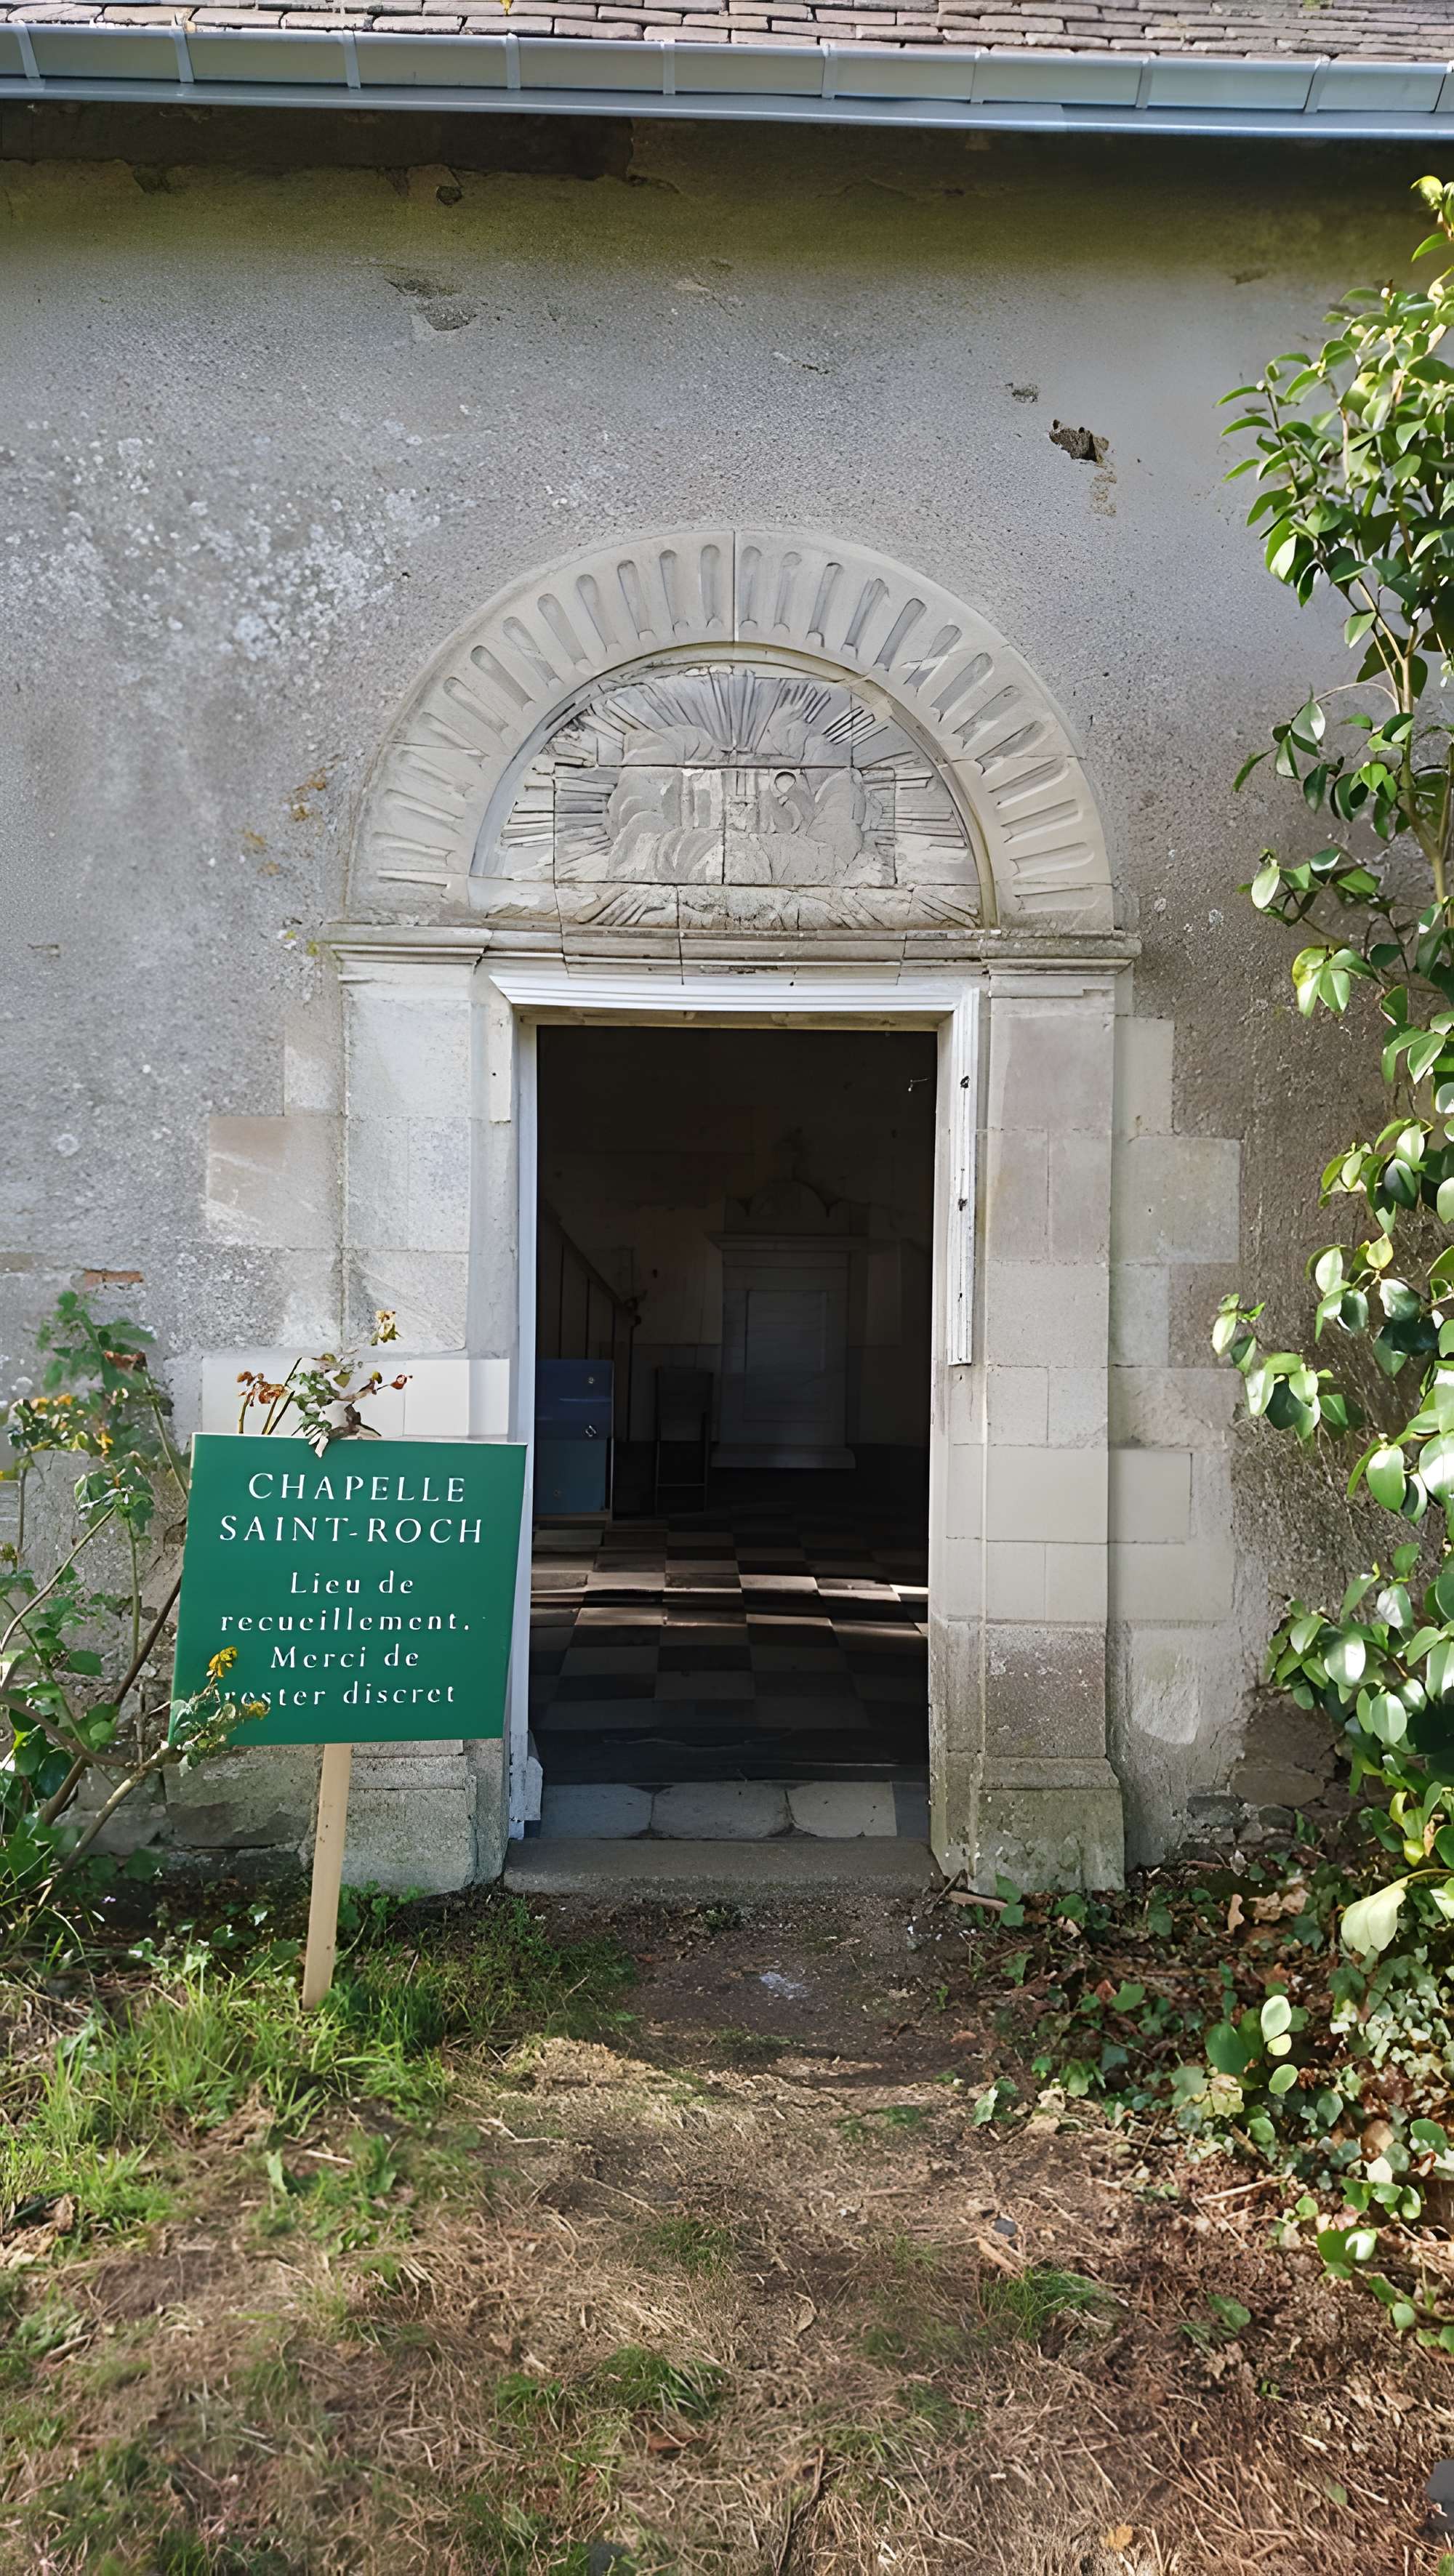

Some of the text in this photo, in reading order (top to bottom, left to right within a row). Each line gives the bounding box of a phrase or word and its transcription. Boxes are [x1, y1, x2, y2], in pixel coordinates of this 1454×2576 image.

[248, 1473, 465, 1503] CHAPELLE
[219, 1515, 483, 1544] SAINT-ROCH
[290, 1570, 414, 1595] Lieu de
[220, 1607, 470, 1632] recueillement.
[270, 1643, 419, 1669] Merci de
[342, 1681, 455, 1704] discret
